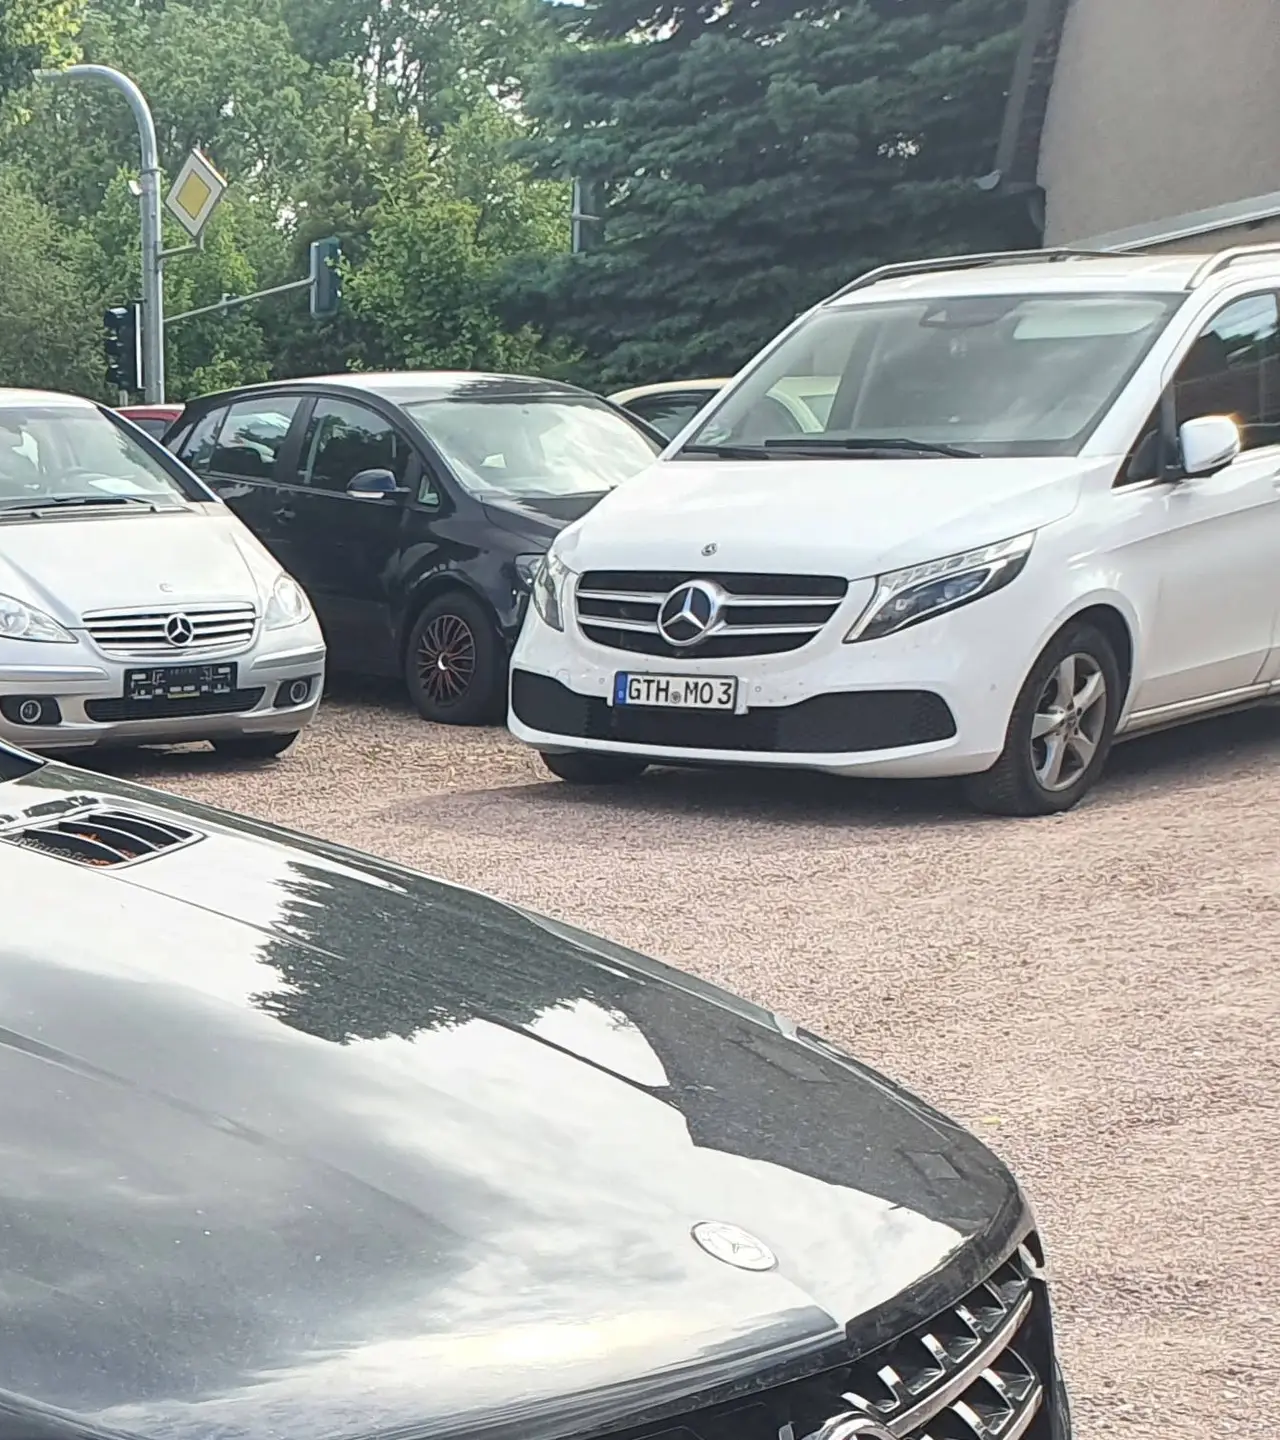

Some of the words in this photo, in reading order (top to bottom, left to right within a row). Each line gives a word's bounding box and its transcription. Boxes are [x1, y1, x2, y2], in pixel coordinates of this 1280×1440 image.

[628, 678, 670, 703] GTH
[684, 681, 714, 704] MO
[717, 682, 733, 705] 3
